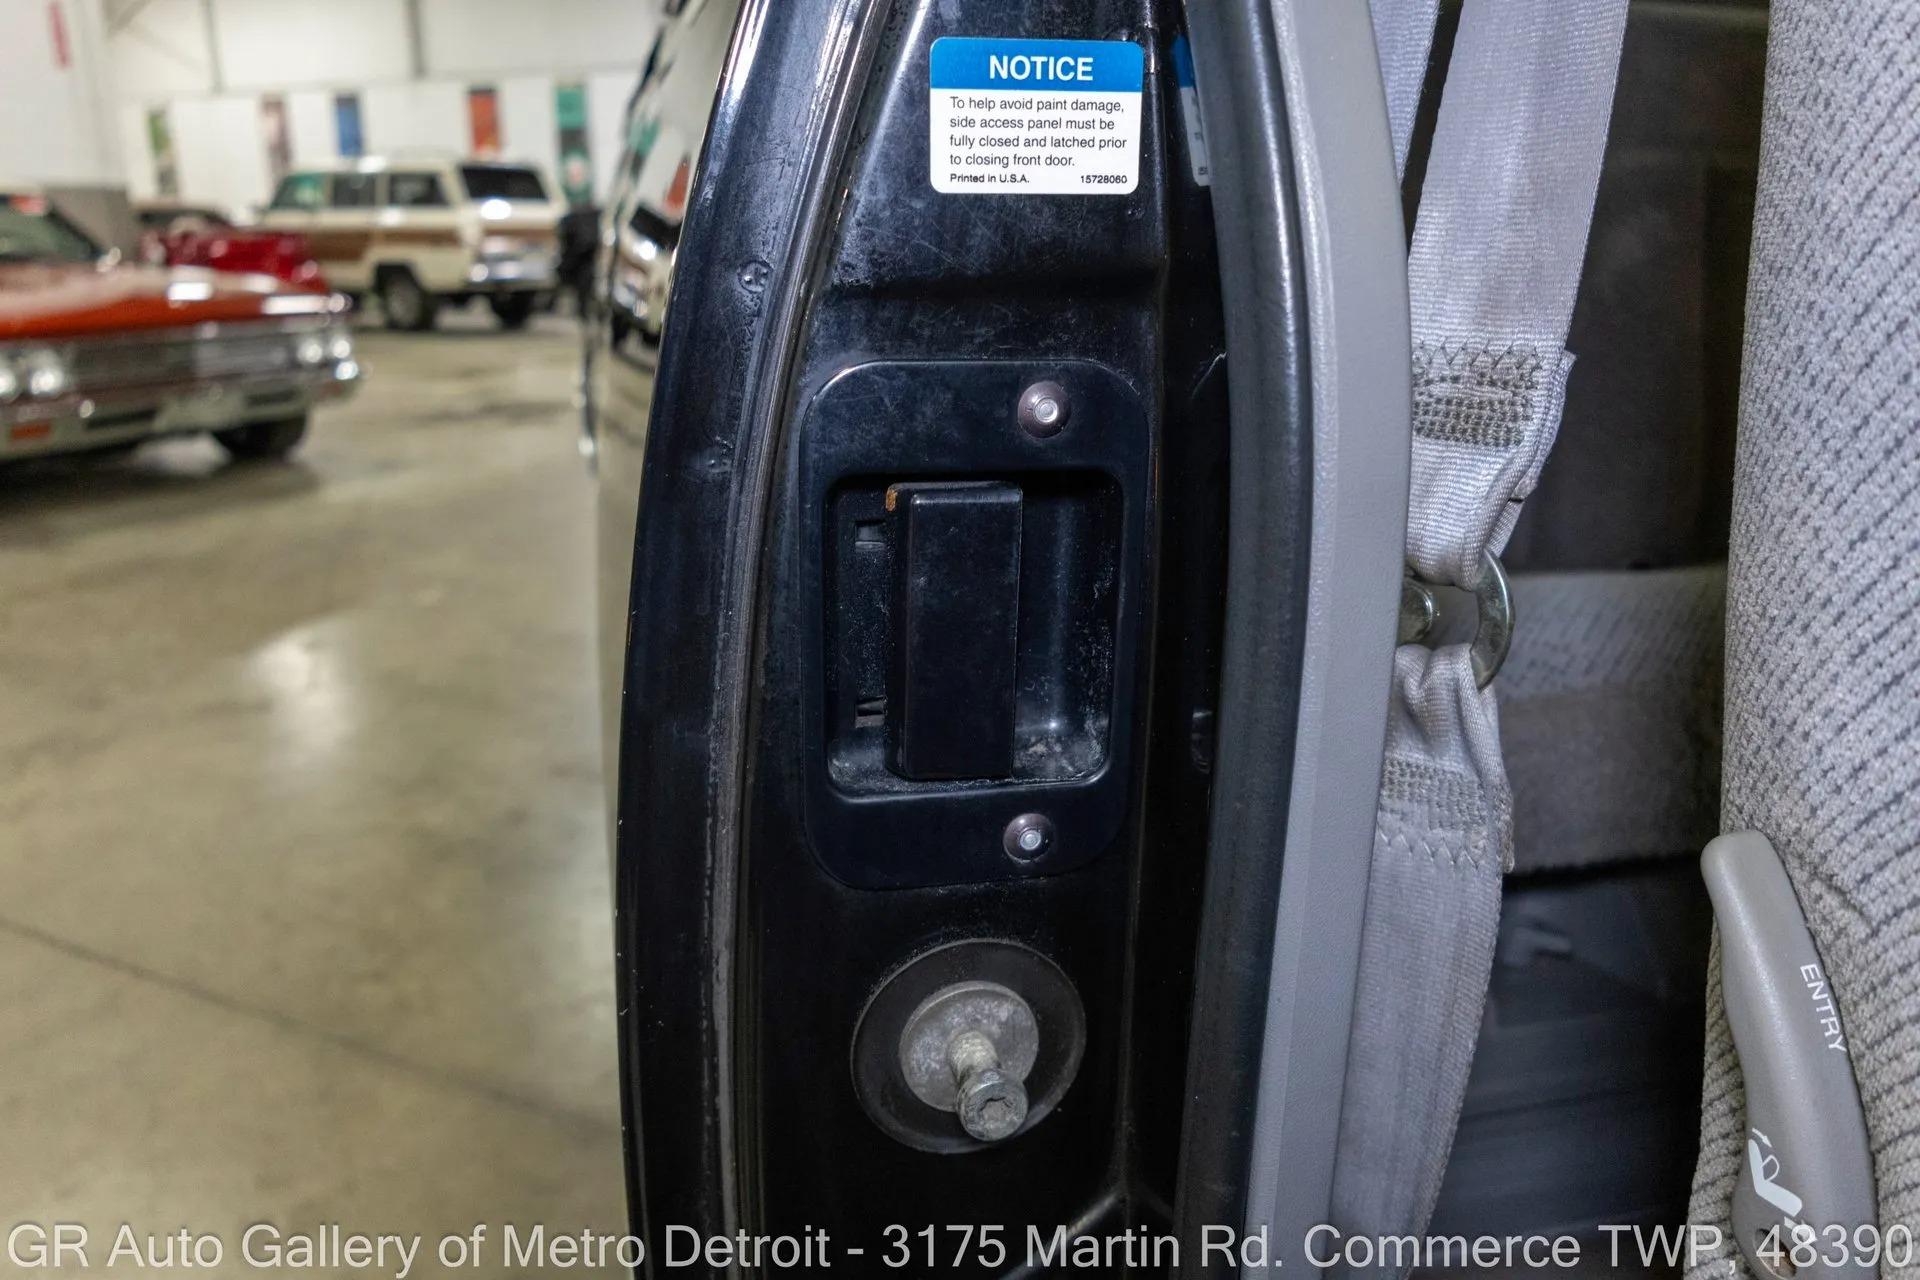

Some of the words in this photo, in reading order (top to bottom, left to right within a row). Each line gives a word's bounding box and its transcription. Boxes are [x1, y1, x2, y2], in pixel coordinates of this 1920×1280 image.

[988, 54, 1094, 81] NOTICE
[950, 96, 965, 109] To
[969, 97, 996, 112] help
[1000, 97, 1033, 110] avoid
[1037, 98, 1067, 114] paint
[1070, 98, 1124, 115] damage,
[950, 115, 976, 128] side
[980, 118, 1024, 129] access
[1027, 116, 1062, 131] panel
[1066, 117, 1096, 130] must
[1099, 118, 1115, 130] be
[950, 134, 974, 150] fully
[979, 134, 1020, 147] closed
[1024, 135, 1047, 148] and
[1050, 135, 1095, 149] latched
[1099, 136, 1127, 152] prior
[950, 153, 962, 165] to
[965, 152, 1009, 167] closing
[1013, 153, 1041, 166] front
[1045, 154, 1075, 167] door.
[950, 173, 985, 183] Printed
[988, 173, 996, 183] in
[999, 173, 1029, 184] U.S.A.
[1080, 174, 1128, 185] 15728060
[1800, 963, 1847, 1053] ENTRY
